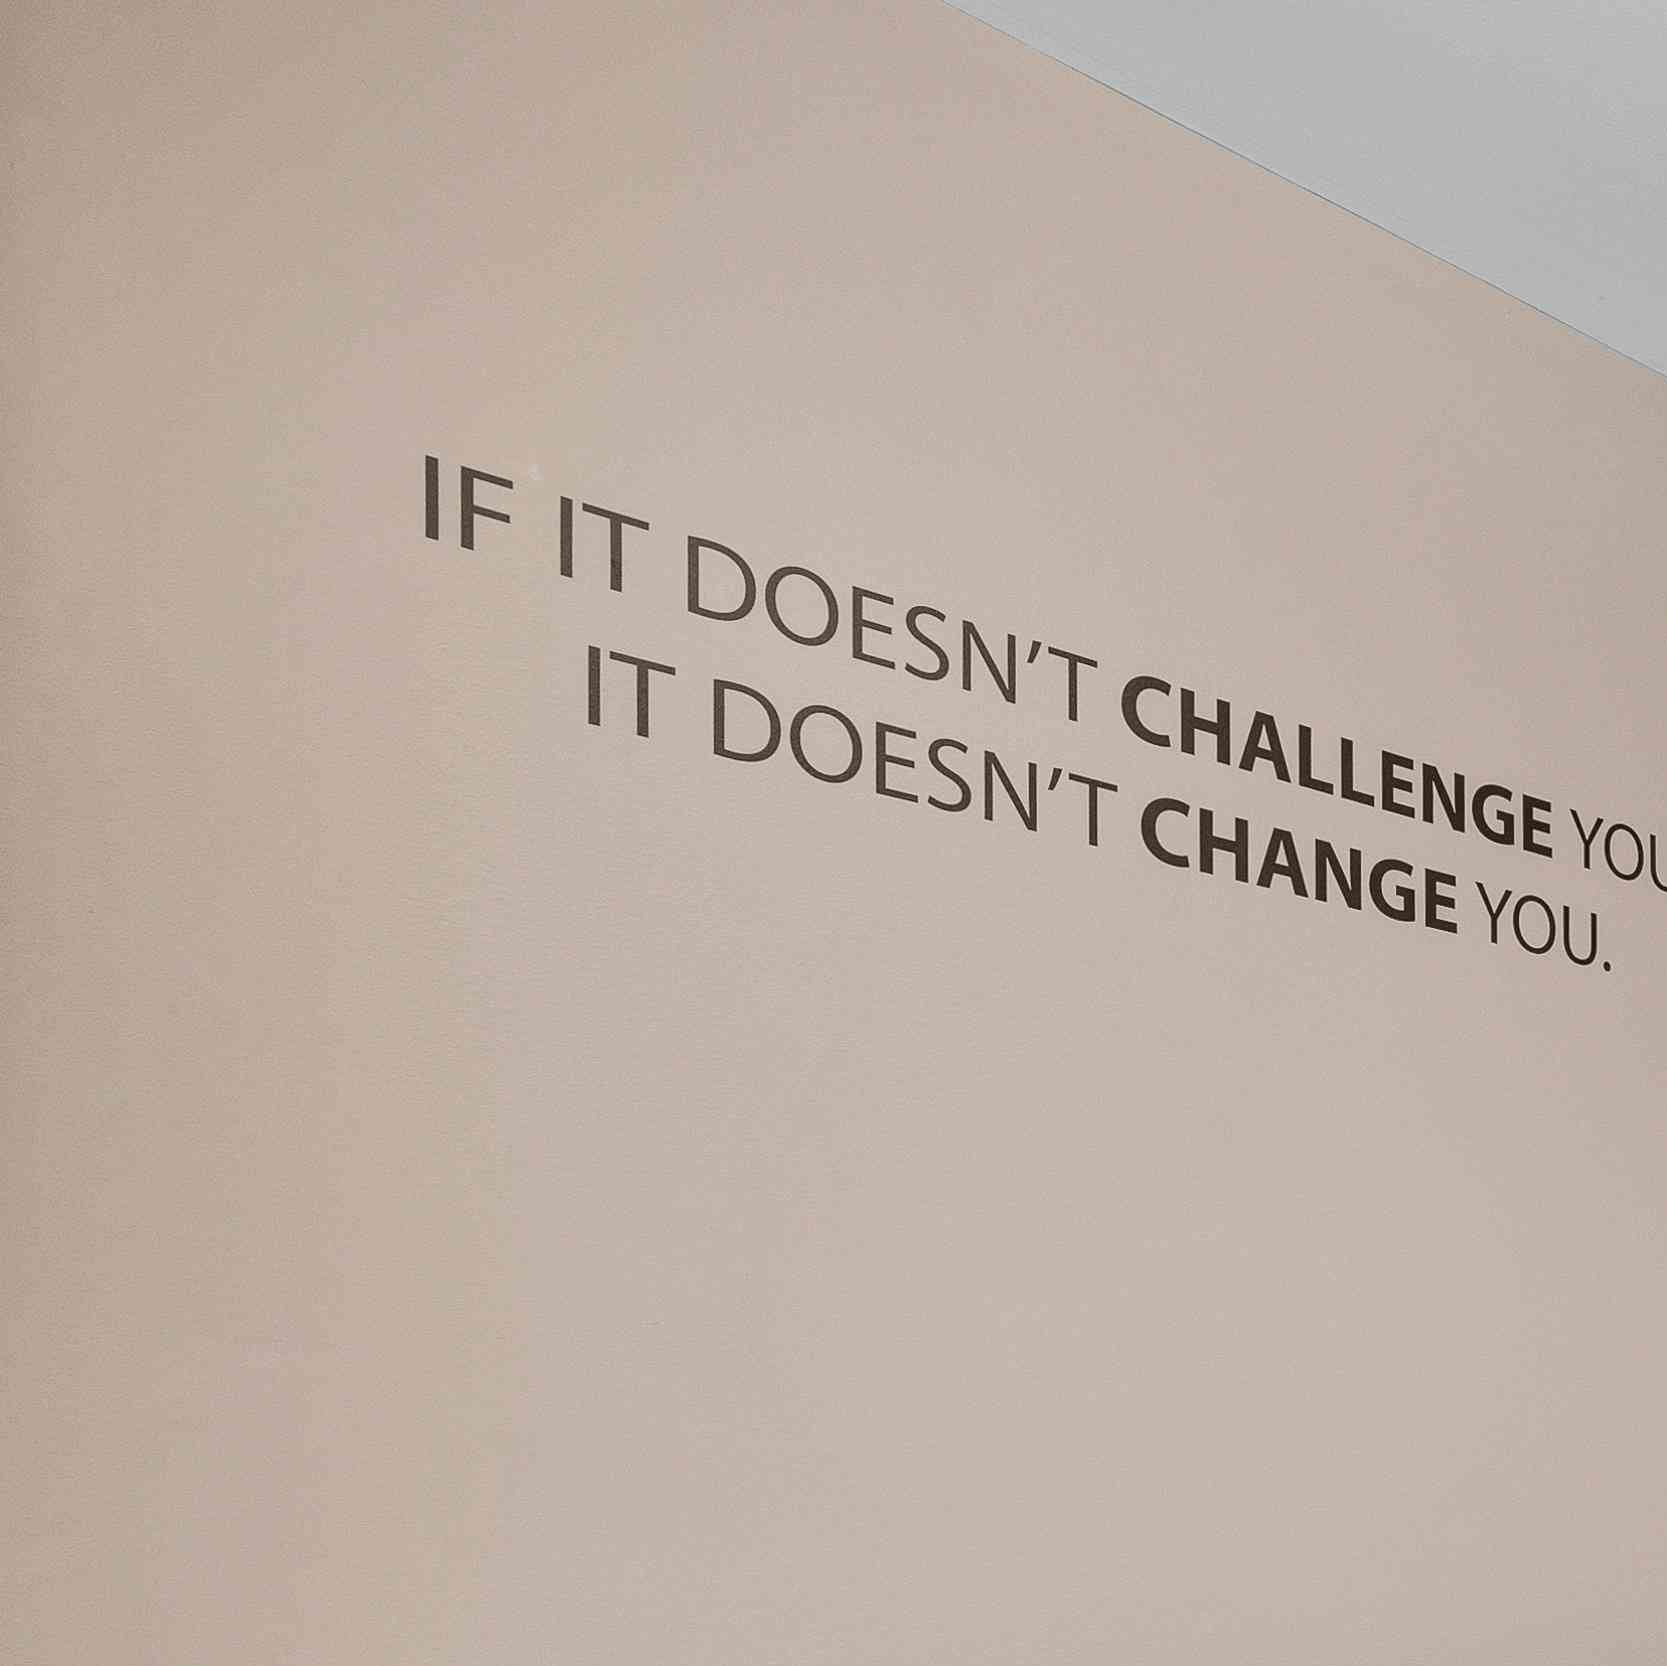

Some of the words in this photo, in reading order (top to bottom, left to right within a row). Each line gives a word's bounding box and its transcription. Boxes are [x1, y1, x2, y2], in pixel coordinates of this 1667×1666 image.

[424, 454, 514, 551] IF
[559, 495, 650, 593] IT
[687, 535, 1098, 722] DOESN'T
[1120, 675, 1553, 859] CHALLENGE
[587, 644, 676, 739] IT
[713, 678, 1118, 847] DOESN'T
[1140, 797, 1458, 935] CHANGE
[1474, 881, 1612, 972] YOU.
